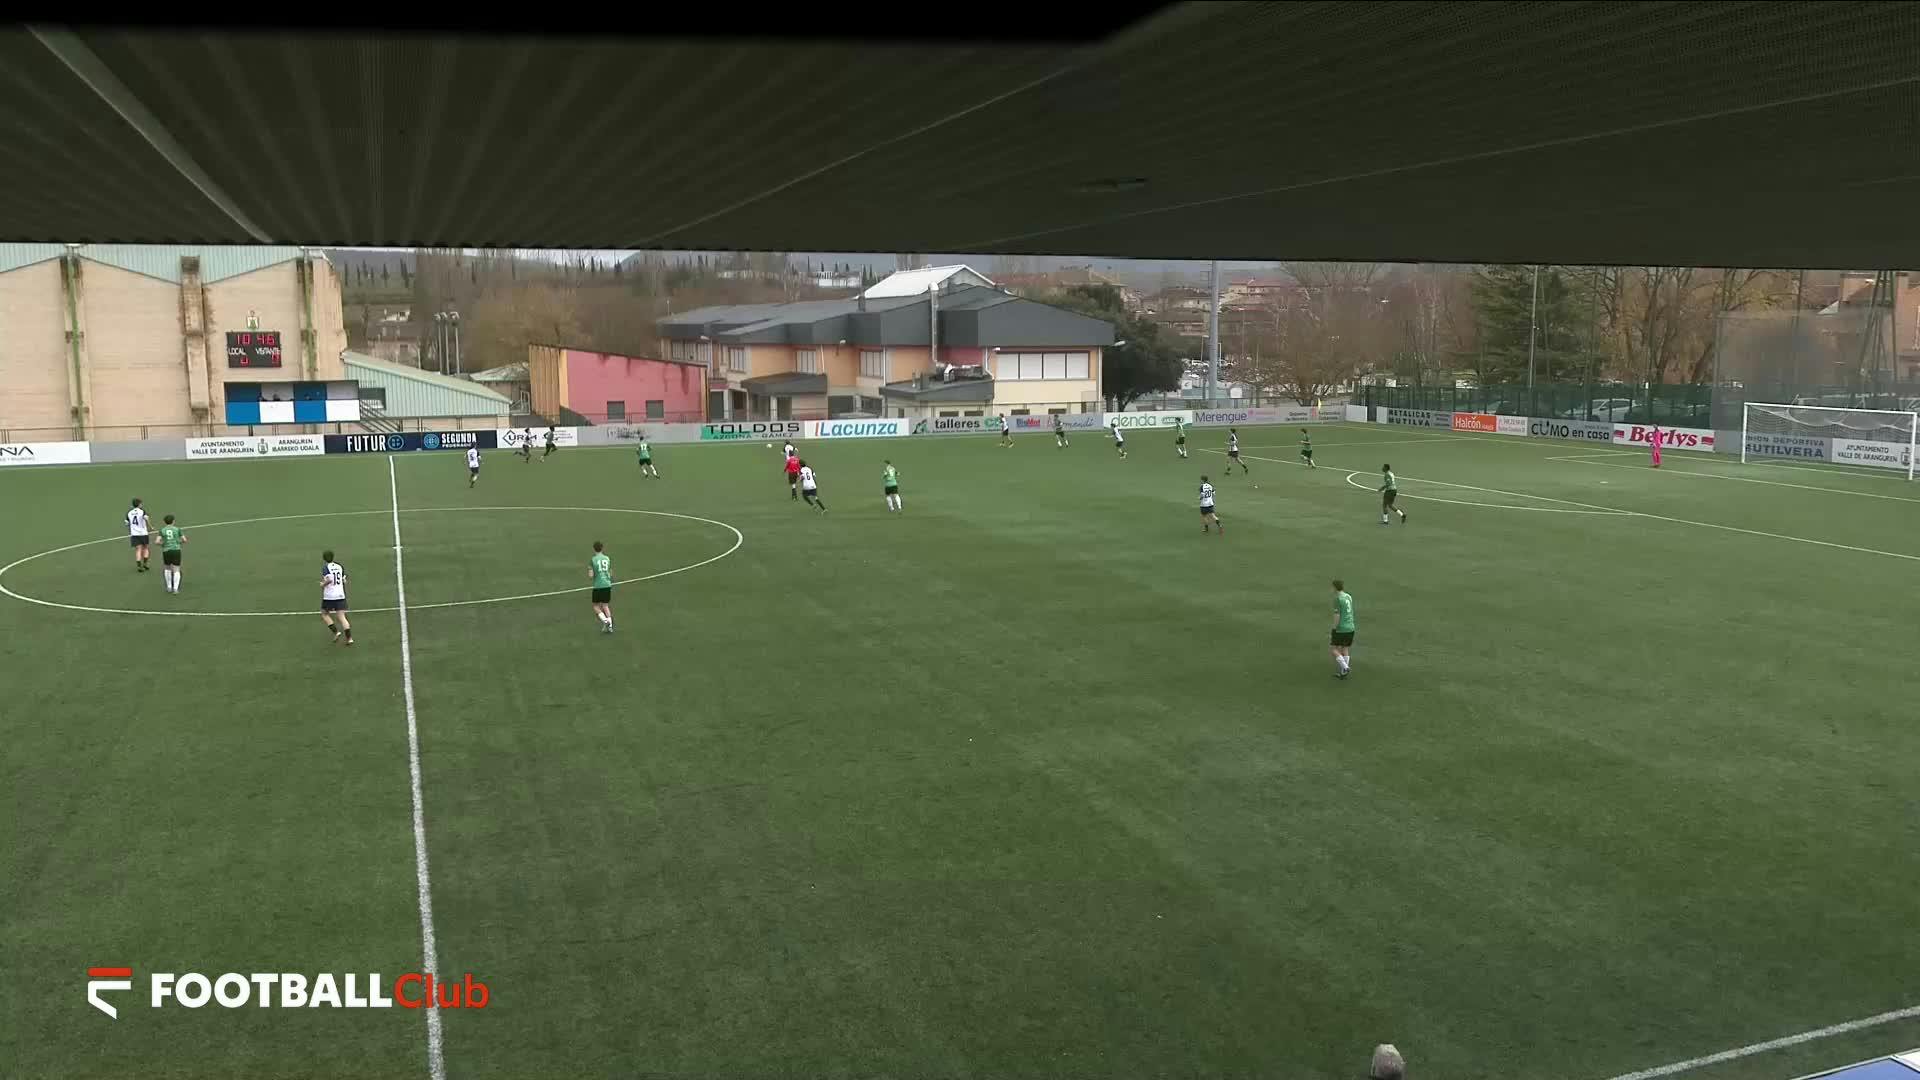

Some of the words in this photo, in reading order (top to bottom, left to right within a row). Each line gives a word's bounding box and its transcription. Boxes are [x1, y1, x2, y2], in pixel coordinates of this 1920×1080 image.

[935, 418, 981, 430] talleres
[1112, 414, 1156, 427] denda
[1195, 412, 1247, 424] Merengue
[706, 422, 800, 434] TOLDOS
[820, 422, 898, 436] Lacunza
[441, 433, 477, 444] SEGUNDA
[1572, 429, 1584, 438] en
[1587, 430, 1610, 440] casa
[347, 435, 387, 452] FUTUR
[1772, 437, 1825, 446] DEPORTIVA
[132, 515, 139, 526] 4
[596, 559, 609, 572] 19
[332, 571, 341, 586] 19
